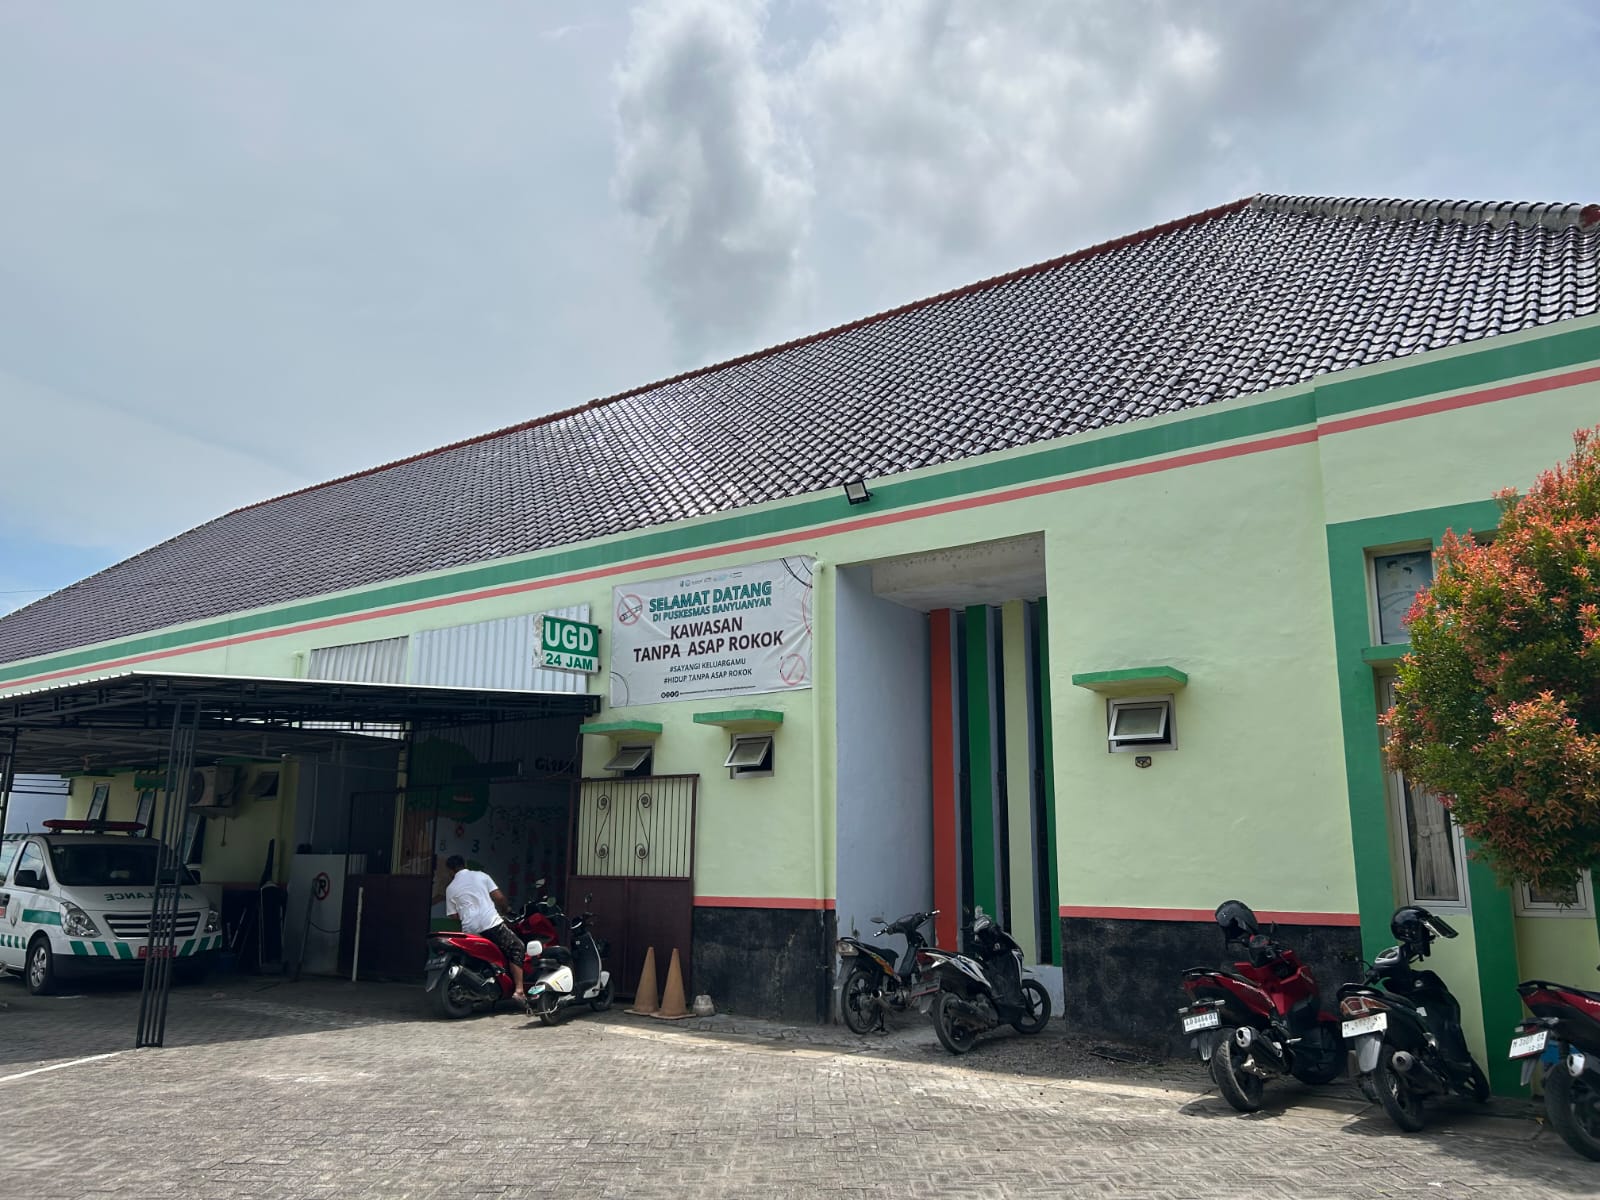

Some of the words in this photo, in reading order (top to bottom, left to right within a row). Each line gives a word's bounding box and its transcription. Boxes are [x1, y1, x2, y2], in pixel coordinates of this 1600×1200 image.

[649, 590, 710, 612] SELAMAT
[714, 581, 772, 603] DATANG
[652, 612, 659, 622] DI
[662, 606, 710, 621] PUSKESMAS
[712, 597, 771, 614] BANYUANYAR
[546, 622, 593, 652] UGD
[670, 617, 742, 640] KAWASAN
[634, 644, 680, 662] TANPA
[688, 638, 724, 656] ASAP
[729, 630, 783, 652] ROKOK
[546, 652, 562, 666] 24
[566, 656, 593, 671] JAM
[670, 662, 700, 672] #SAYANGI
[702, 658, 746, 669] KELUARGAMU
[664, 674, 688, 684] #HIDUP
[689, 673, 709, 682] TANPA
[711, 671, 726, 680] ASAP
[728, 668, 752, 677] ROKOK
